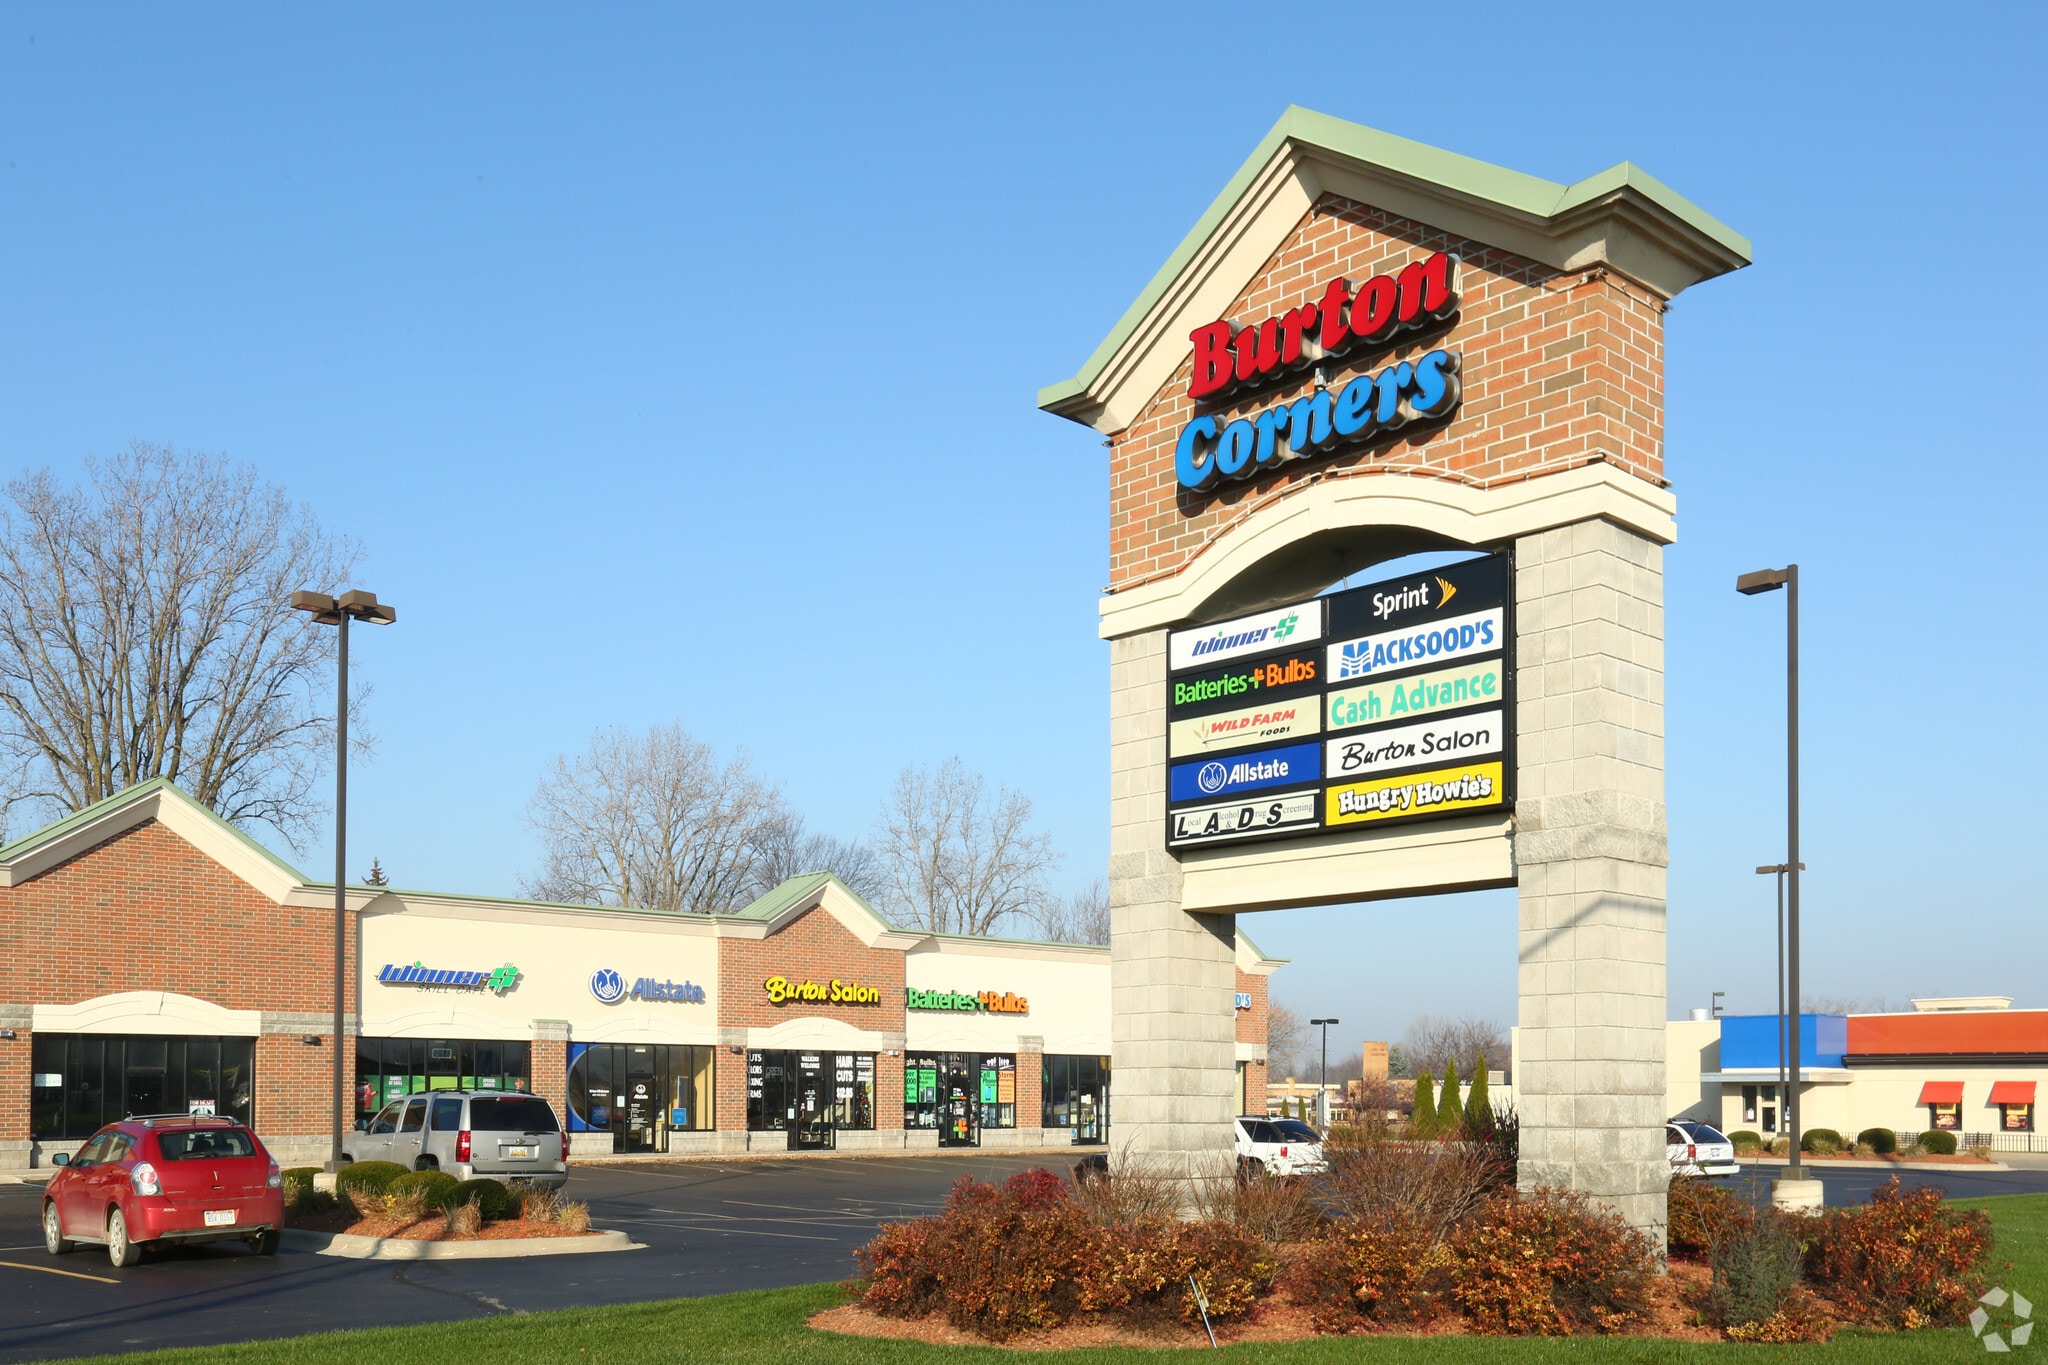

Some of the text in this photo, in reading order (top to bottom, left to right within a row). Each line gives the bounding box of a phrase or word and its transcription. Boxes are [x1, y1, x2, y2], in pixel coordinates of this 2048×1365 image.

[1187, 251, 1454, 399] Burton
[1175, 350, 1453, 488] Corners
[1373, 582, 1429, 621] Sprint
[1340, 619, 1494, 678] MACKSOOD'S
[1331, 672, 1497, 726] Cash Advance
[1211, 708, 1296, 733] WILD FARM
[1259, 726, 1290, 737] FOODS
[1341, 729, 1490, 771] Burton Salon
[1228, 759, 1289, 785] Allstate
[1338, 773, 1493, 817] Hungry Howie's
[417, 985, 449, 994] SKILL
[629, 977, 704, 1001] Allstate
[765, 976, 880, 1003] Burton Salon
[836, 1056, 853, 1068] HAIR
[836, 1070, 854, 1082] CUTS
